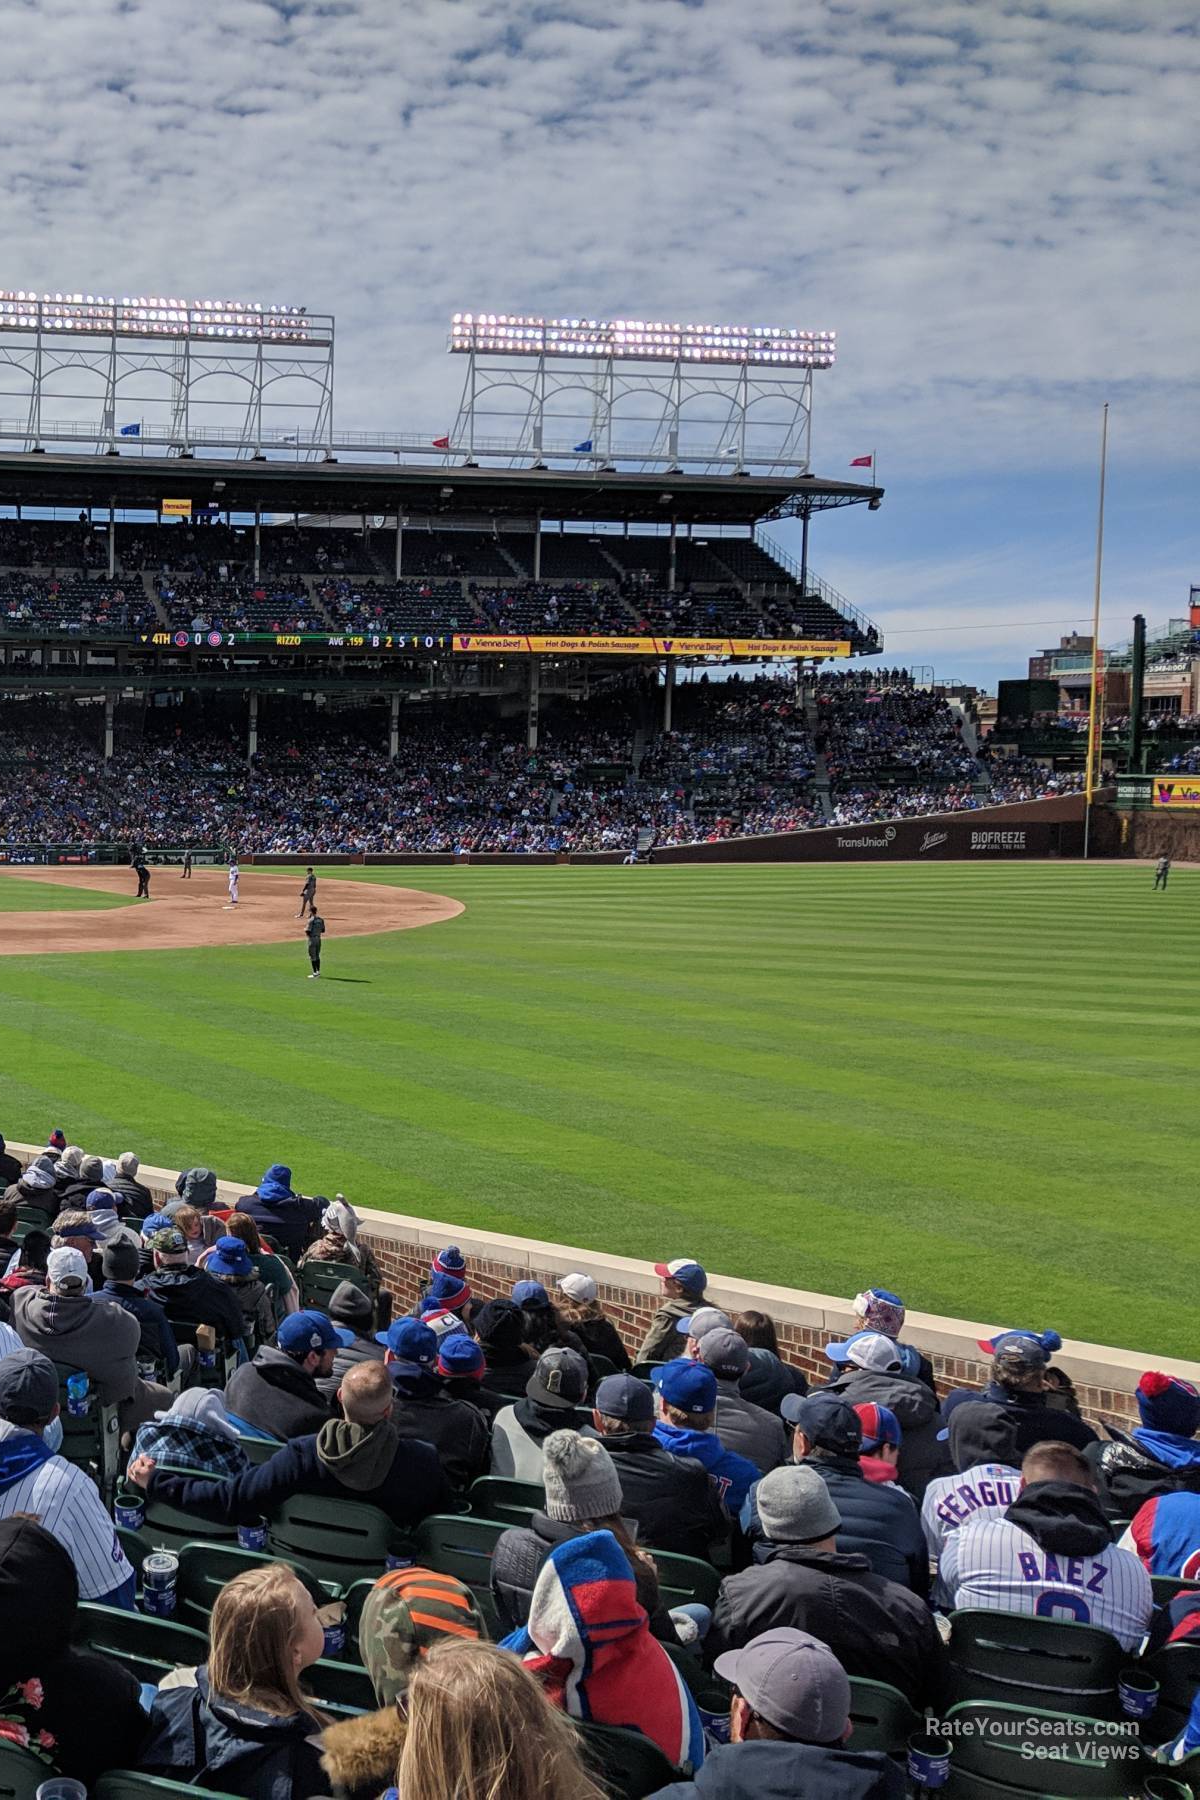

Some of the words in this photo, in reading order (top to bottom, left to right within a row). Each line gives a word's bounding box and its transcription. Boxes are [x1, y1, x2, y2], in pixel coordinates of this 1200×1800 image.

[152, 633, 170, 645] 4TH
[194, 633, 202, 645] 0
[227, 633, 235, 646] 2
[276, 635, 301, 646] RIZZO
[328, 637, 344, 646] AVG
[346, 636, 364, 646] .159
[372, 636, 380, 647] B
[385, 636, 393, 647] 2
[399, 636, 406, 647] S
[412, 637, 419, 647] 1
[438, 637, 445, 647] 1
[475, 639, 502, 647] Vienna
[545, 640, 559, 648] Hot
[560, 641, 578, 649] Dogs
[588, 640, 610, 648] Polish
[762, 644, 779, 652] Dogs
[788, 644, 809, 652] Polish
[810, 645, 838, 653] Sausage
[837, 837, 889, 848] TransUnion
[1018, 1551, 1108, 1594] BAEZ
